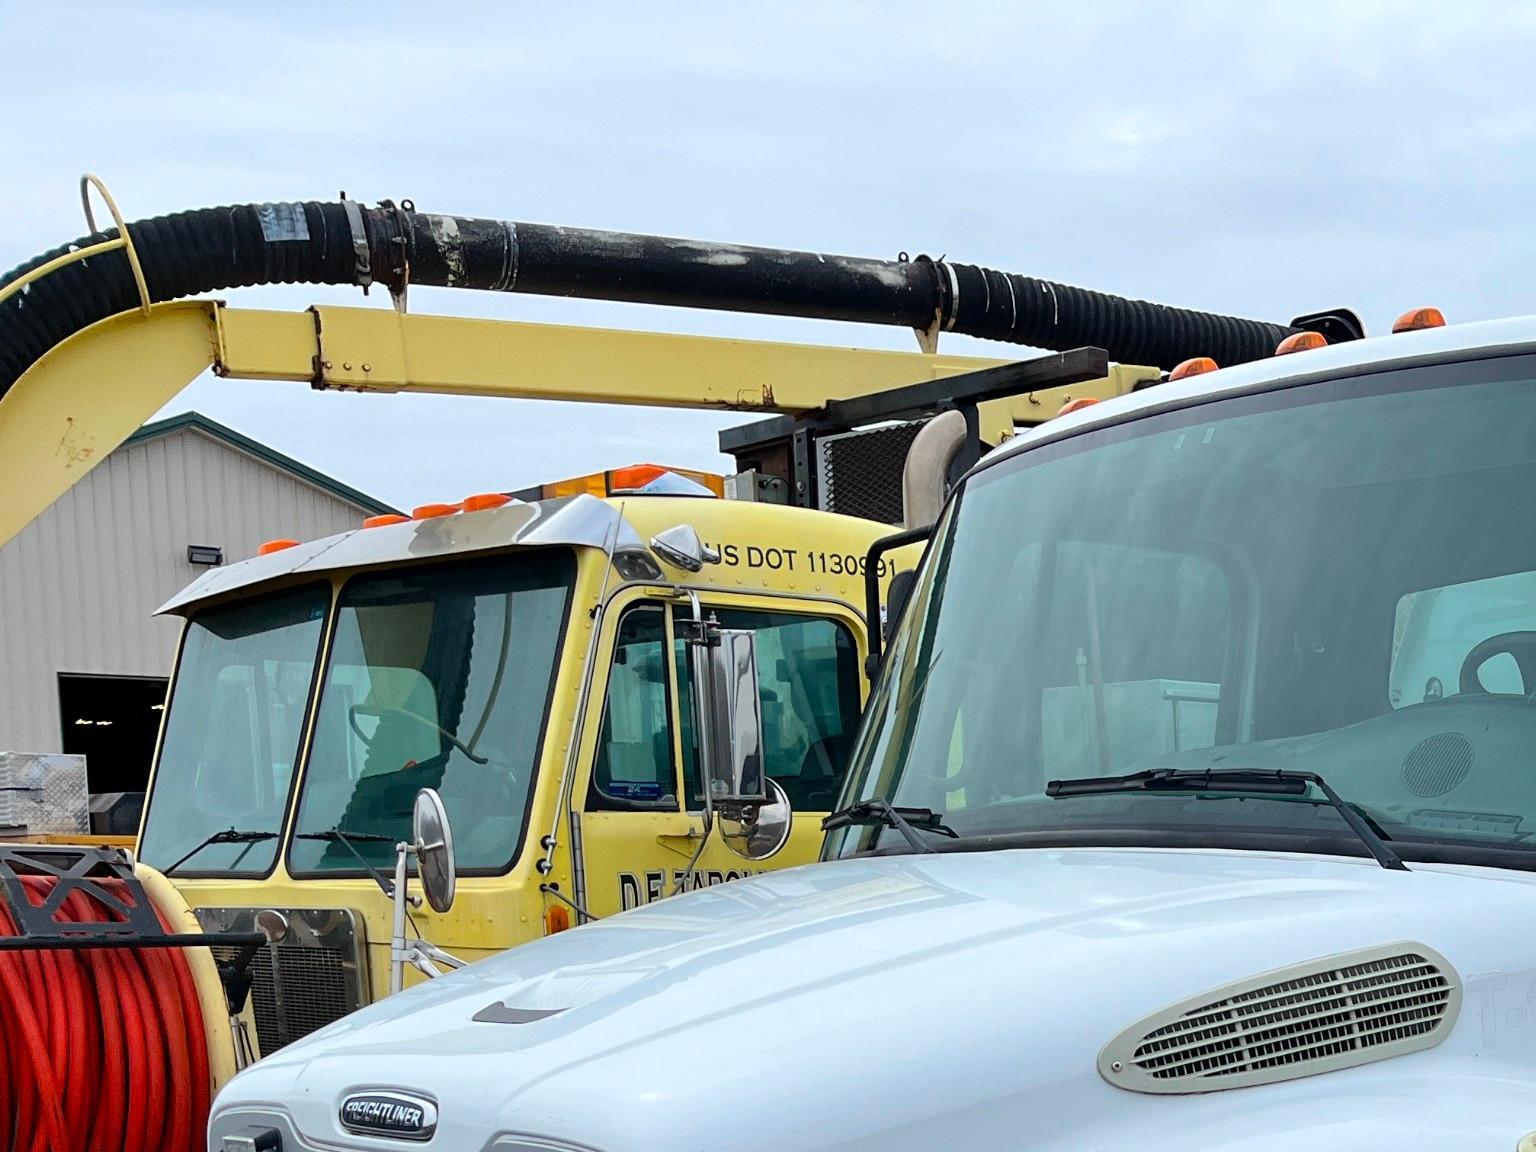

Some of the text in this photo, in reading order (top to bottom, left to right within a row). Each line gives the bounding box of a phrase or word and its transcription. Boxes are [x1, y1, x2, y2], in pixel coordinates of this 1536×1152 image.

[704, 543, 740, 566] US
[747, 546, 797, 571] DOT
[346, 1101, 422, 1128] FREIGHTLINER
